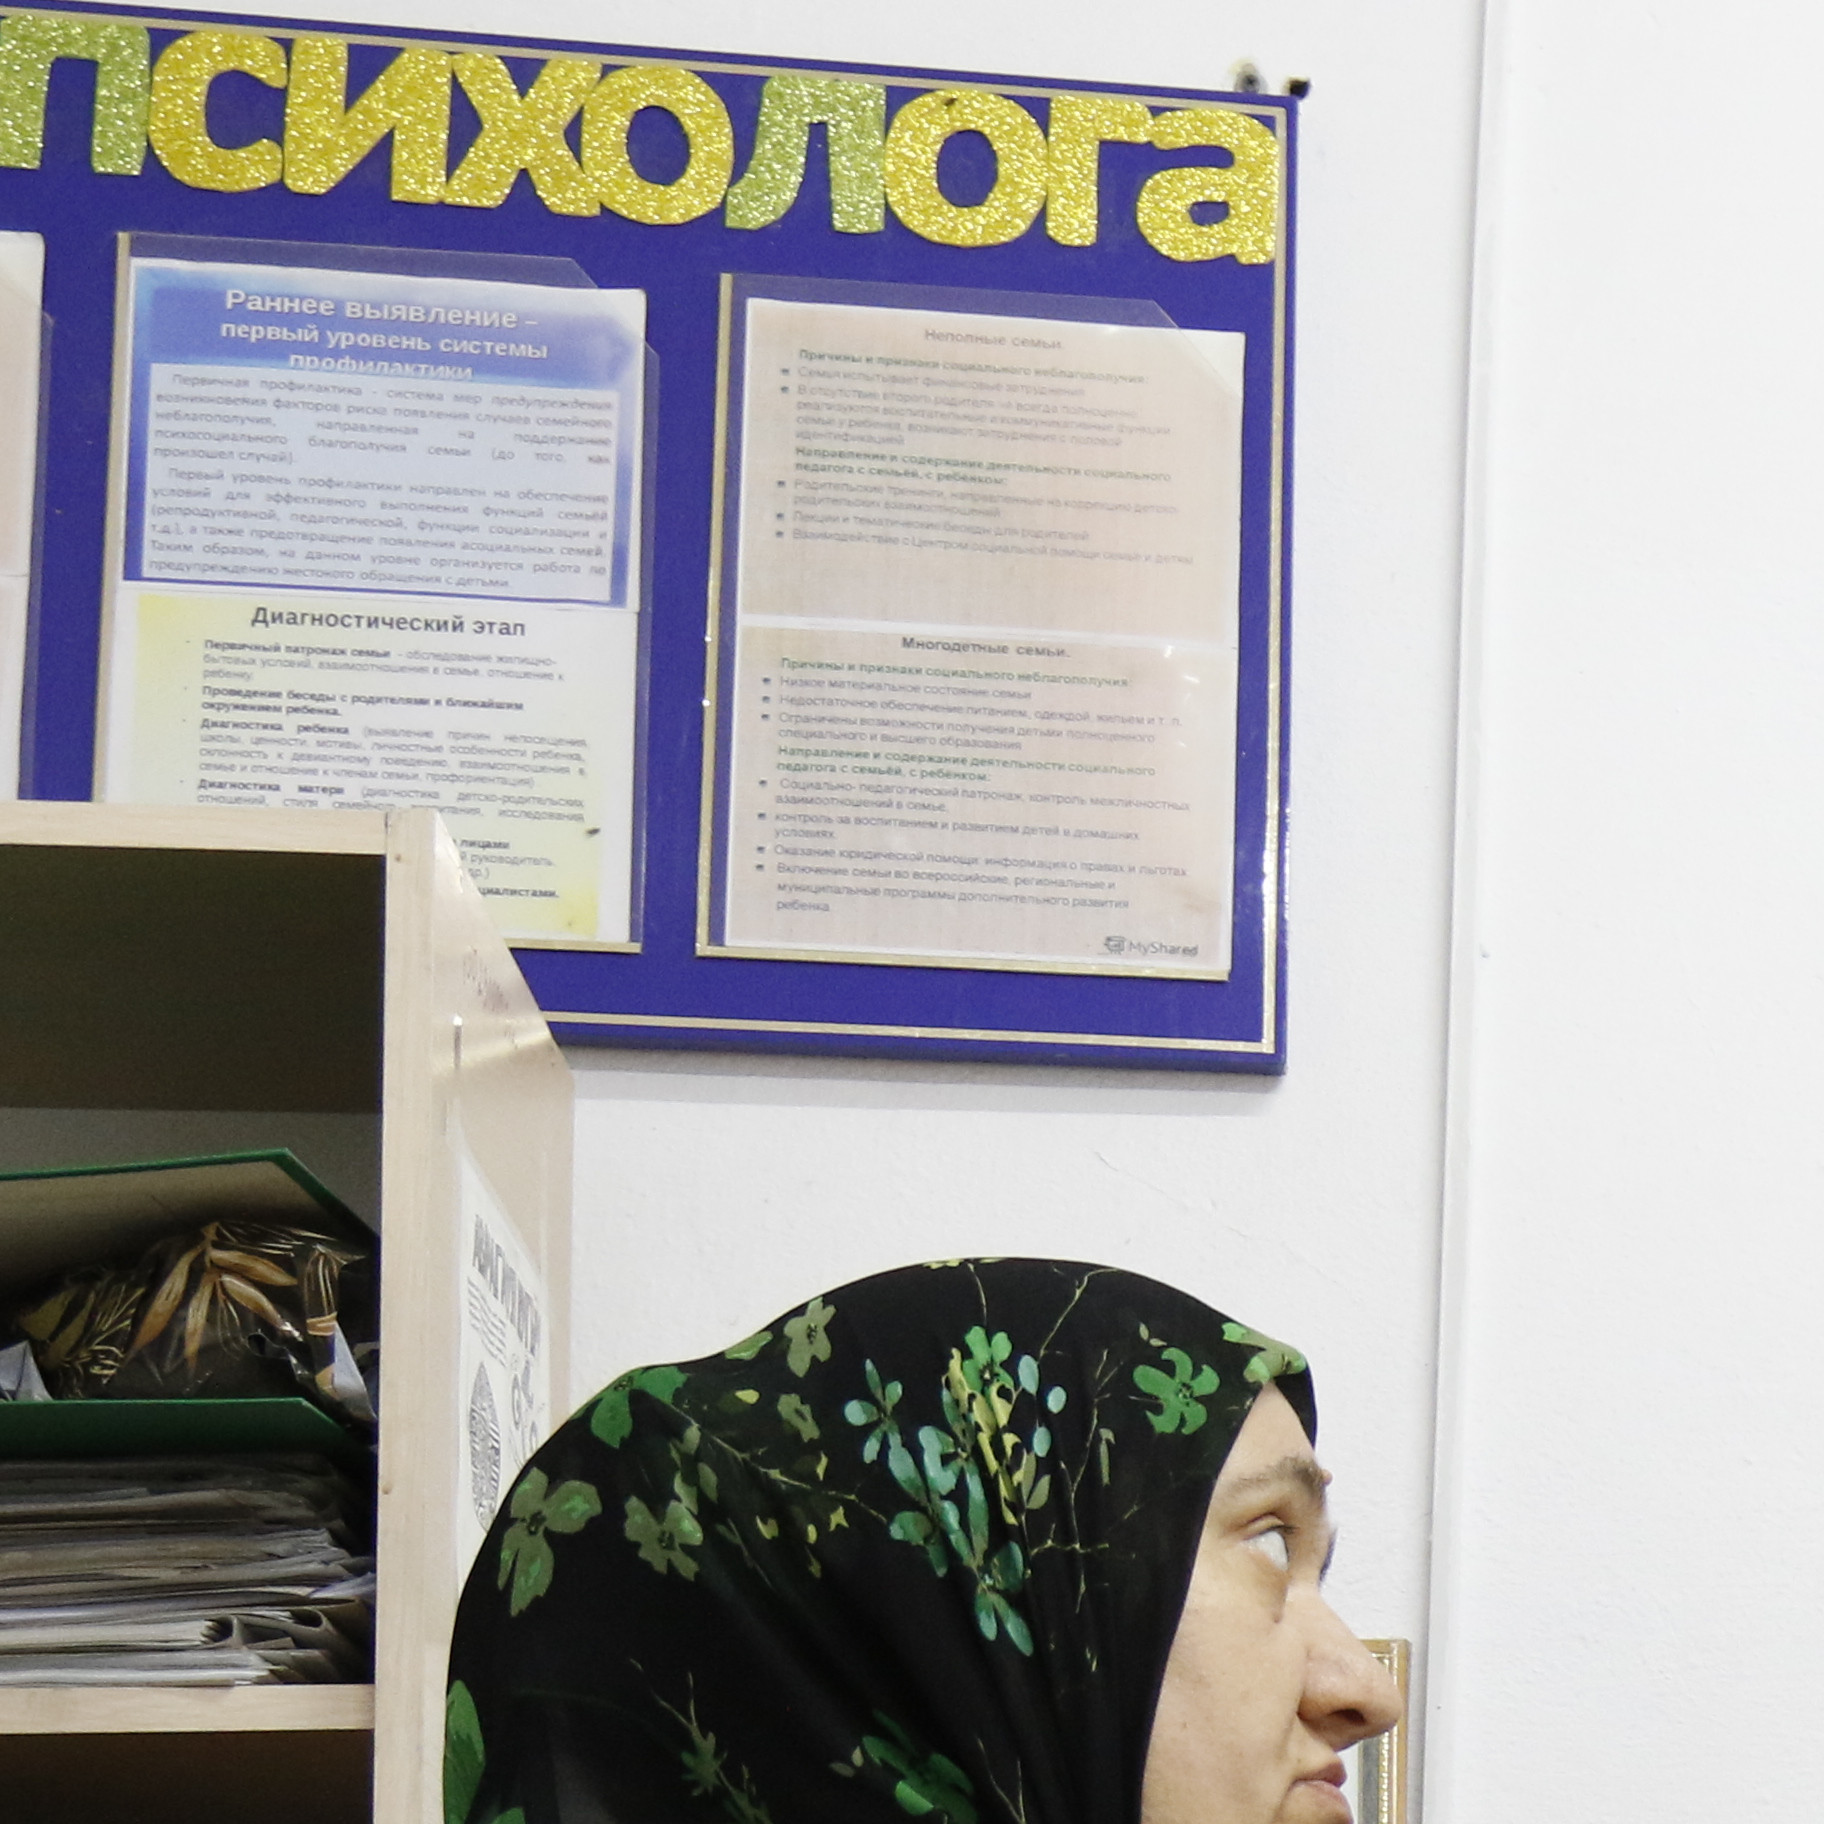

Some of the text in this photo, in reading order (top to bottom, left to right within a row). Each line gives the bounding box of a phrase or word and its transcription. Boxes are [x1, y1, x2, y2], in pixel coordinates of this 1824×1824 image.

[0, 13, 1279, 266] психолога
[225, 288, 337, 317] Раннее
[345, 300, 519, 330] выявление
[220, 321, 549, 360] первый уровень системы
[289, 352, 474, 381] профилактики
[251, 606, 527, 638] Диагностический этап
[901, 638, 1008, 654] Многодетные
[780, 658, 844, 672] Причины
[859, 664, 922, 676] признаки
[925, 668, 1014, 681] социального
[776, 762, 835, 774] педагога
[777, 745, 869, 760] Направление
[884, 753, 967, 766] содержание
[971, 757, 1064, 771] деятельности
[1068, 763, 1155, 776] социального
[1129, 940, 1200, 958] MyShared
